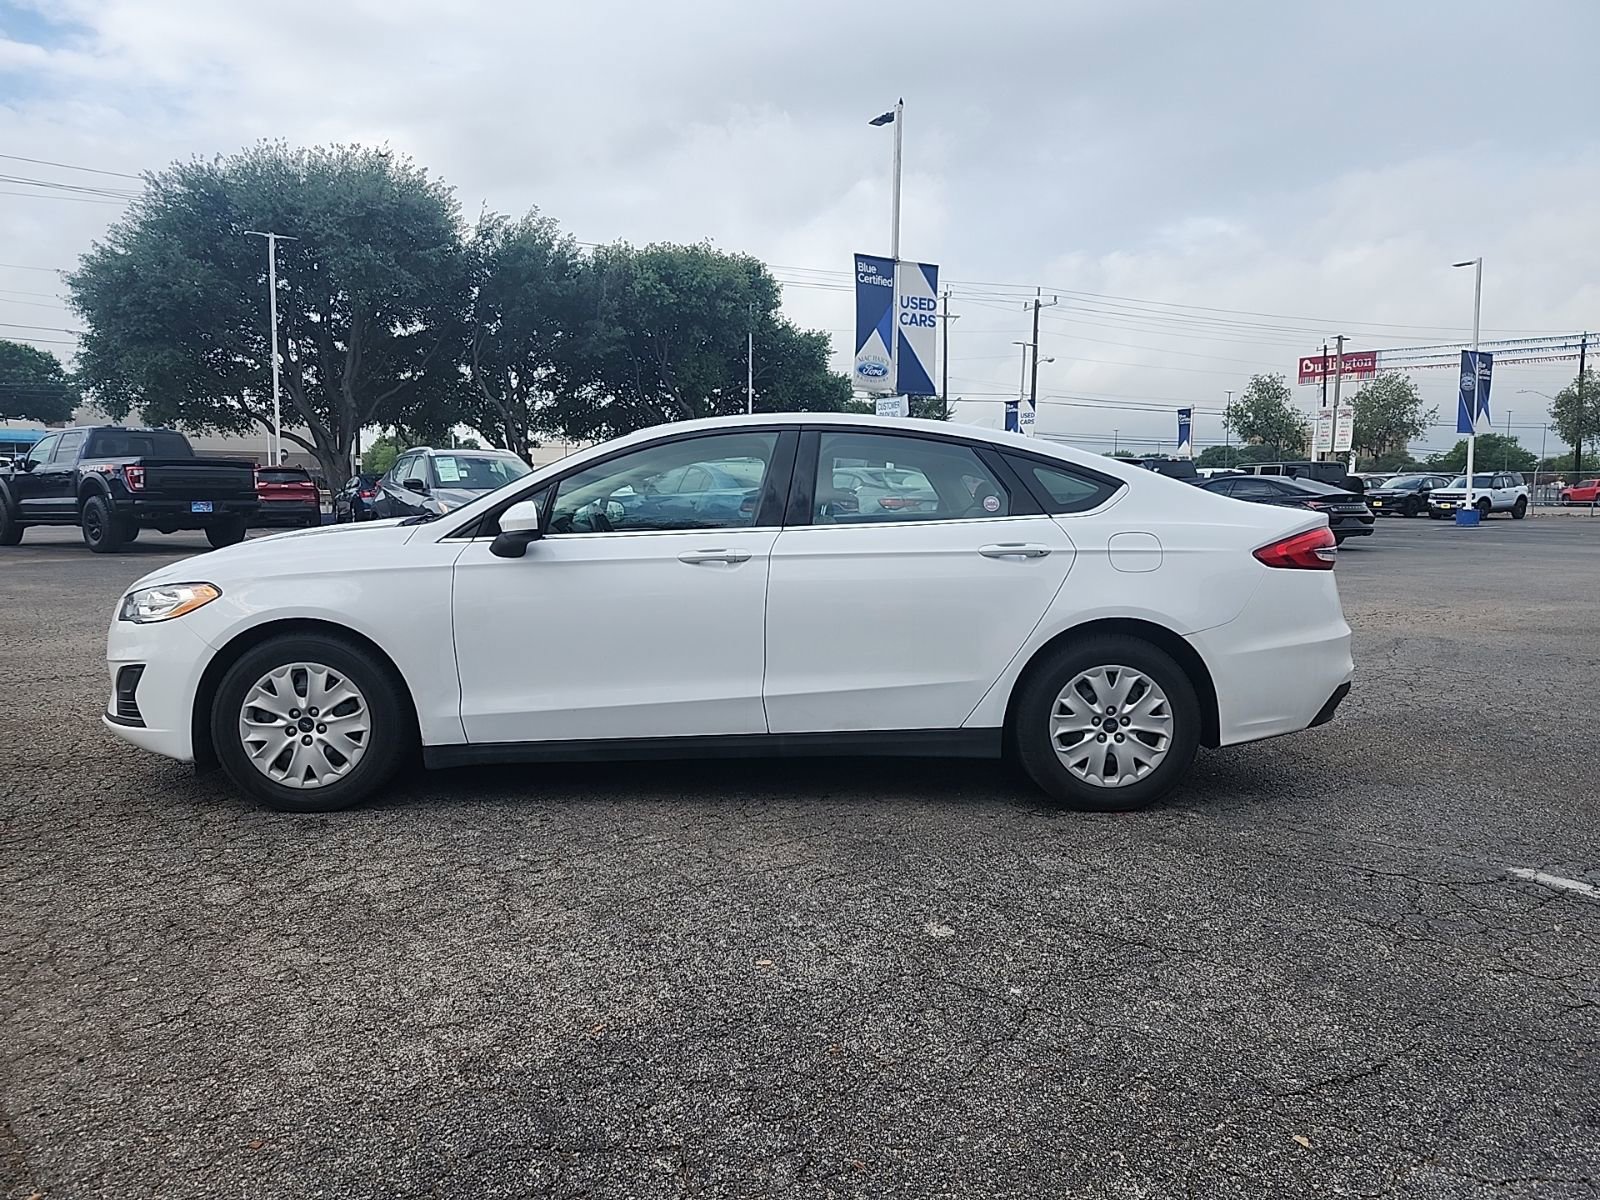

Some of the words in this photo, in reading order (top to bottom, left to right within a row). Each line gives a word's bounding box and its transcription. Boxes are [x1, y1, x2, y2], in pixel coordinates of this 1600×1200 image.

[857, 262, 877, 274] Blue
[857, 273, 893, 287] Certified
[900, 295, 937, 311] USED
[899, 312, 936, 328] CARS
[862, 363, 884, 376] Ford
